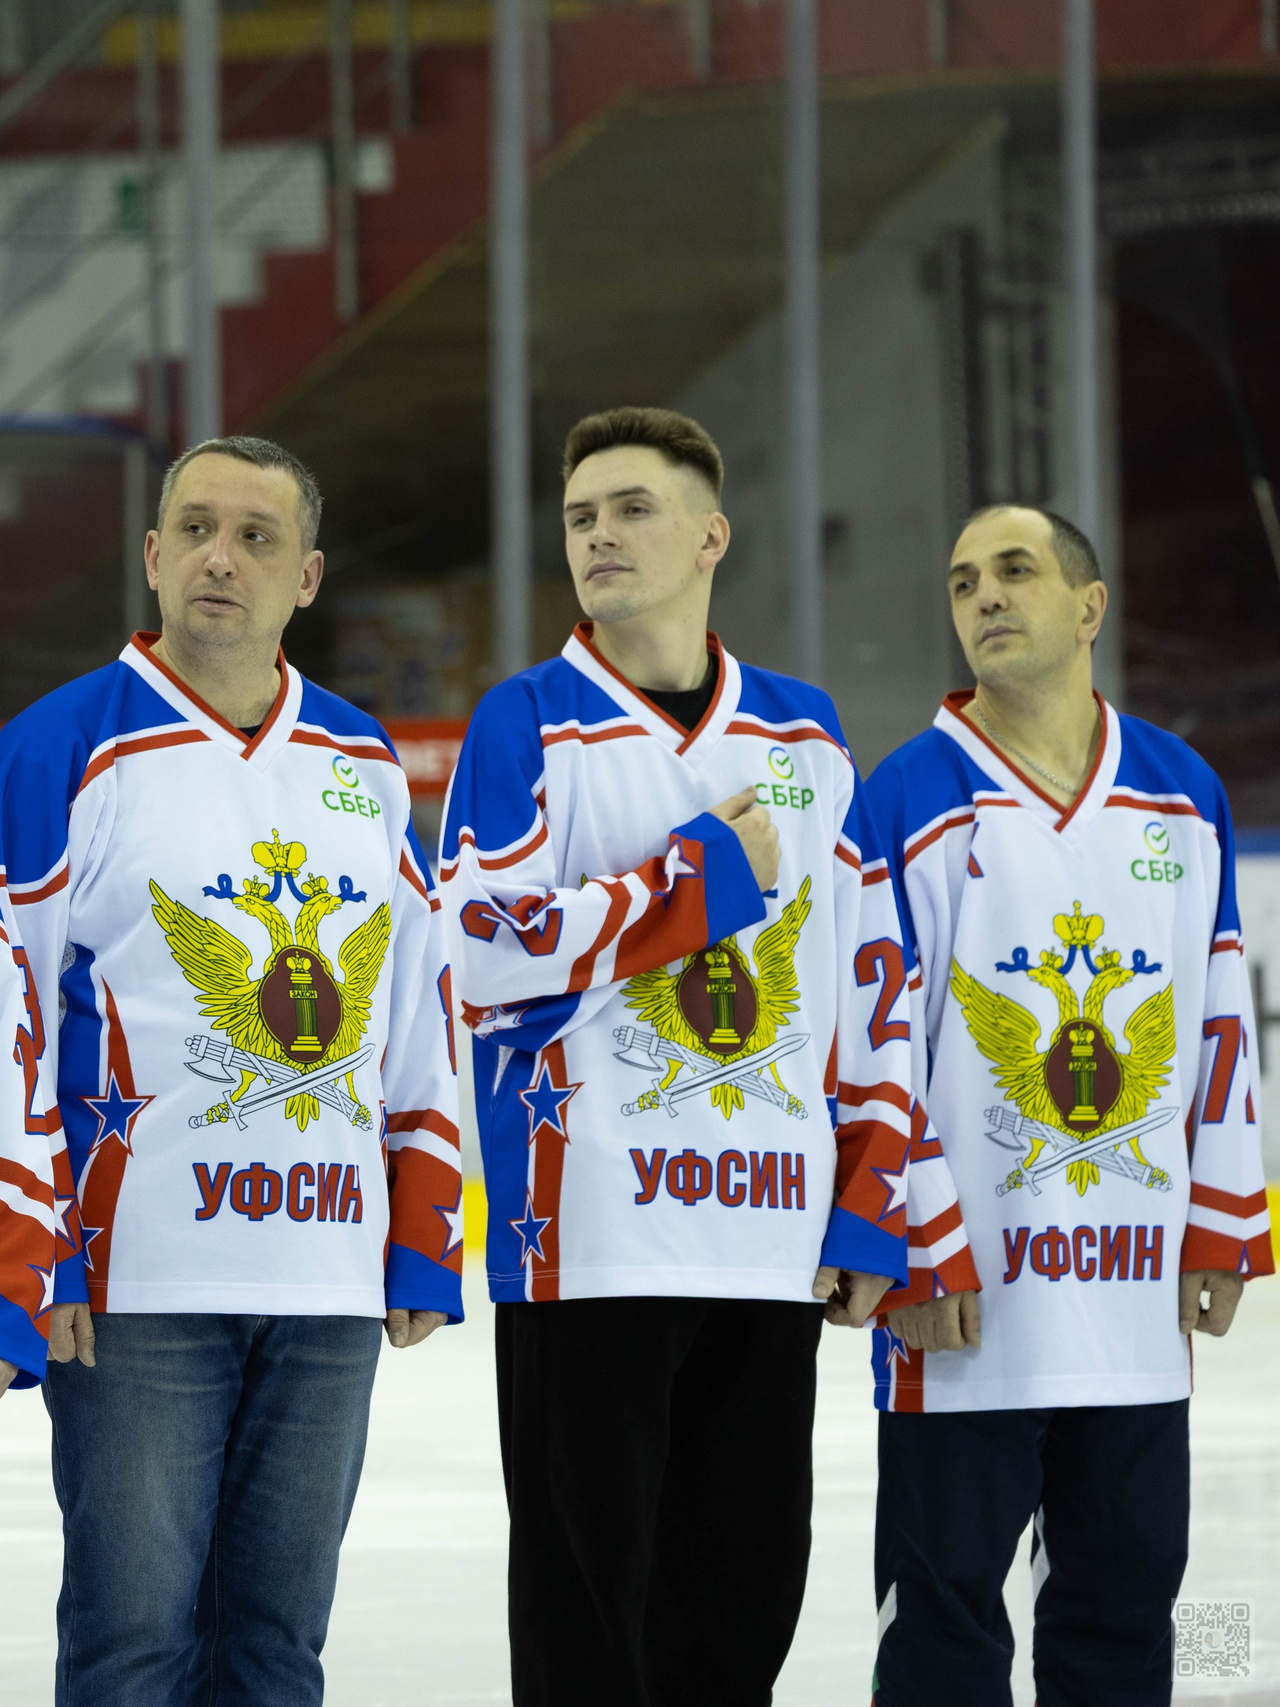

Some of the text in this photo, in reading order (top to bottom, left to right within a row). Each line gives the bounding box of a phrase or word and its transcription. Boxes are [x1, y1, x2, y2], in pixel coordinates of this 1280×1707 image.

[322, 790, 380, 819] СБЕР
[755, 782, 815, 810] СБЕР
[1130, 859, 1184, 884] СБЕР
[291, 990, 316, 999] ЗАКОН
[192, 1162, 363, 1225] УФСИН
[628, 1148, 805, 1211] УФСИН
[1002, 1225, 1164, 1285] УФСИН
